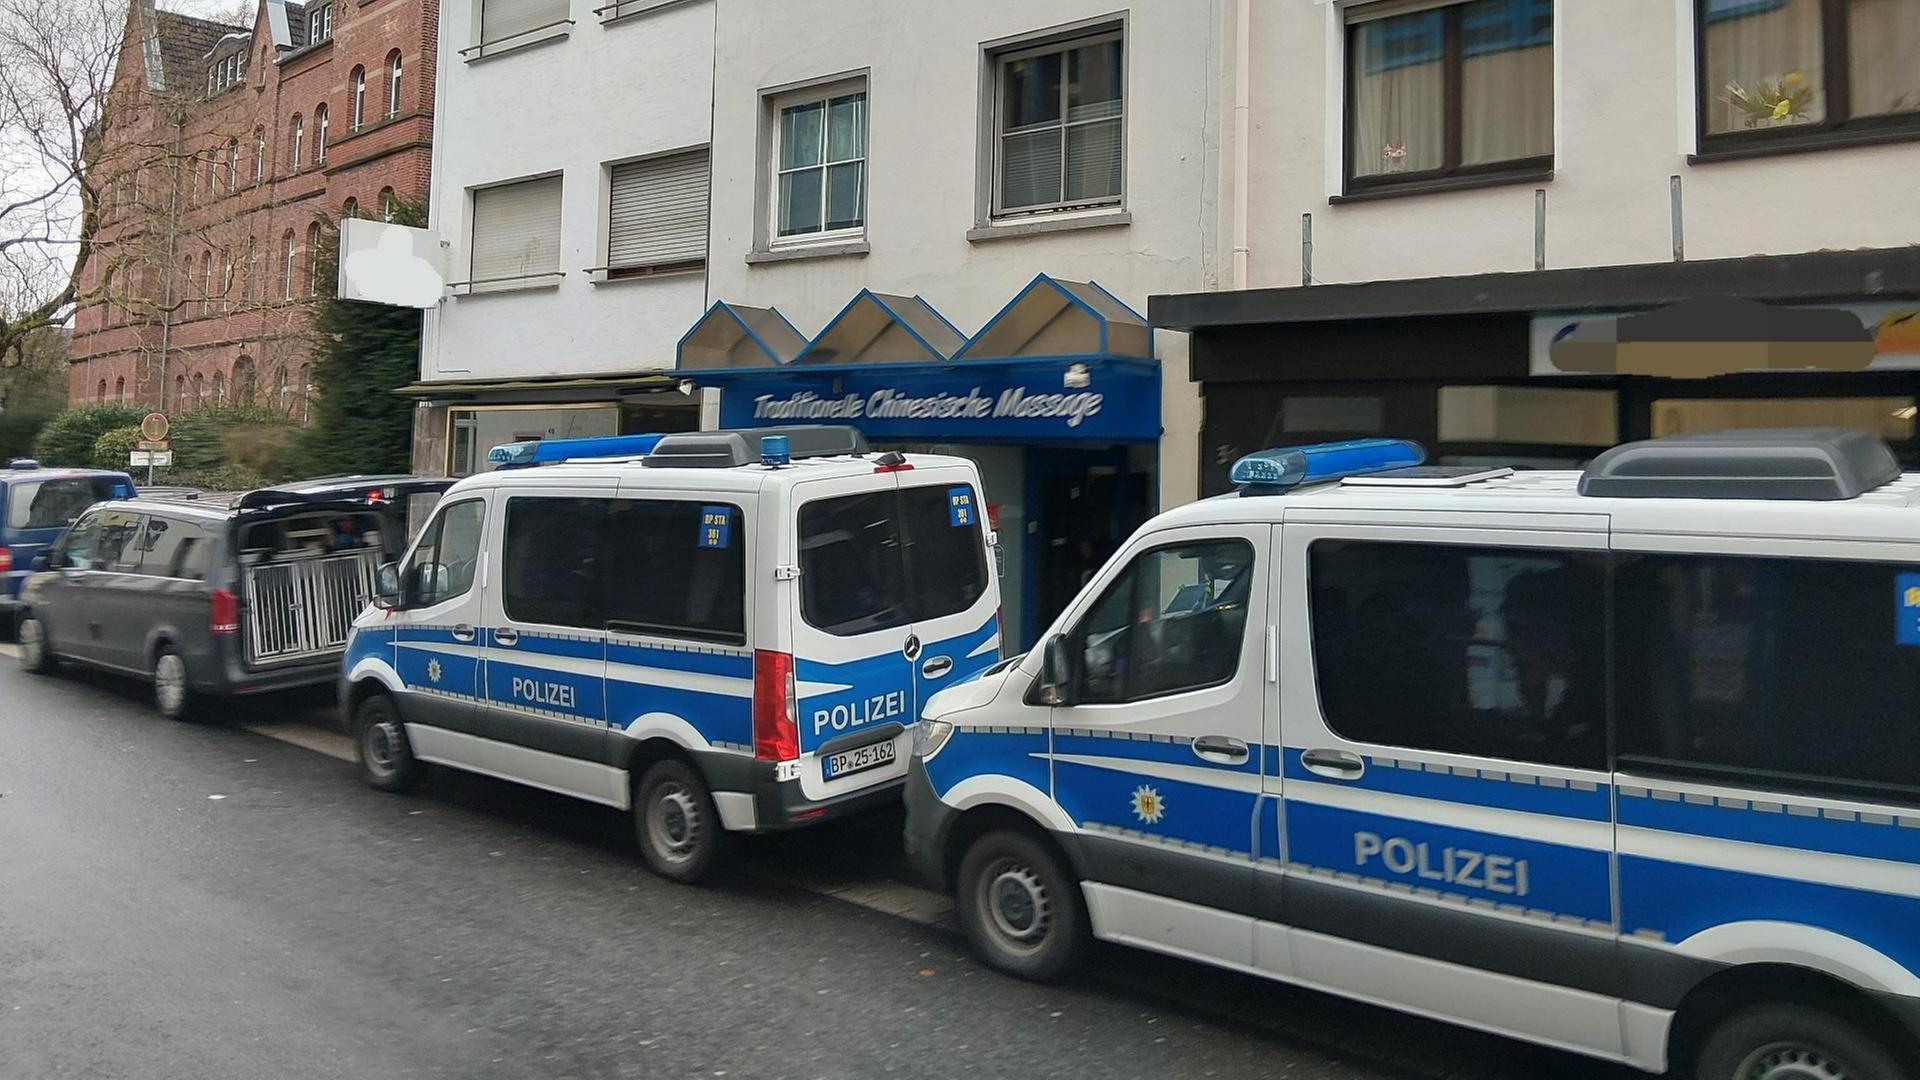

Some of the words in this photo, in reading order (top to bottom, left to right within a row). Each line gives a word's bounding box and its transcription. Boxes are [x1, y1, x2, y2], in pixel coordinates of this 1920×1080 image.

[754, 391, 865, 419] Traditionelle
[865, 388, 993, 418] Chinesische
[992, 386, 1104, 427] Massage
[512, 677, 575, 708] POLIZEI
[814, 690, 904, 735] POLIZEI
[1354, 831, 1528, 896] POLIZEI
